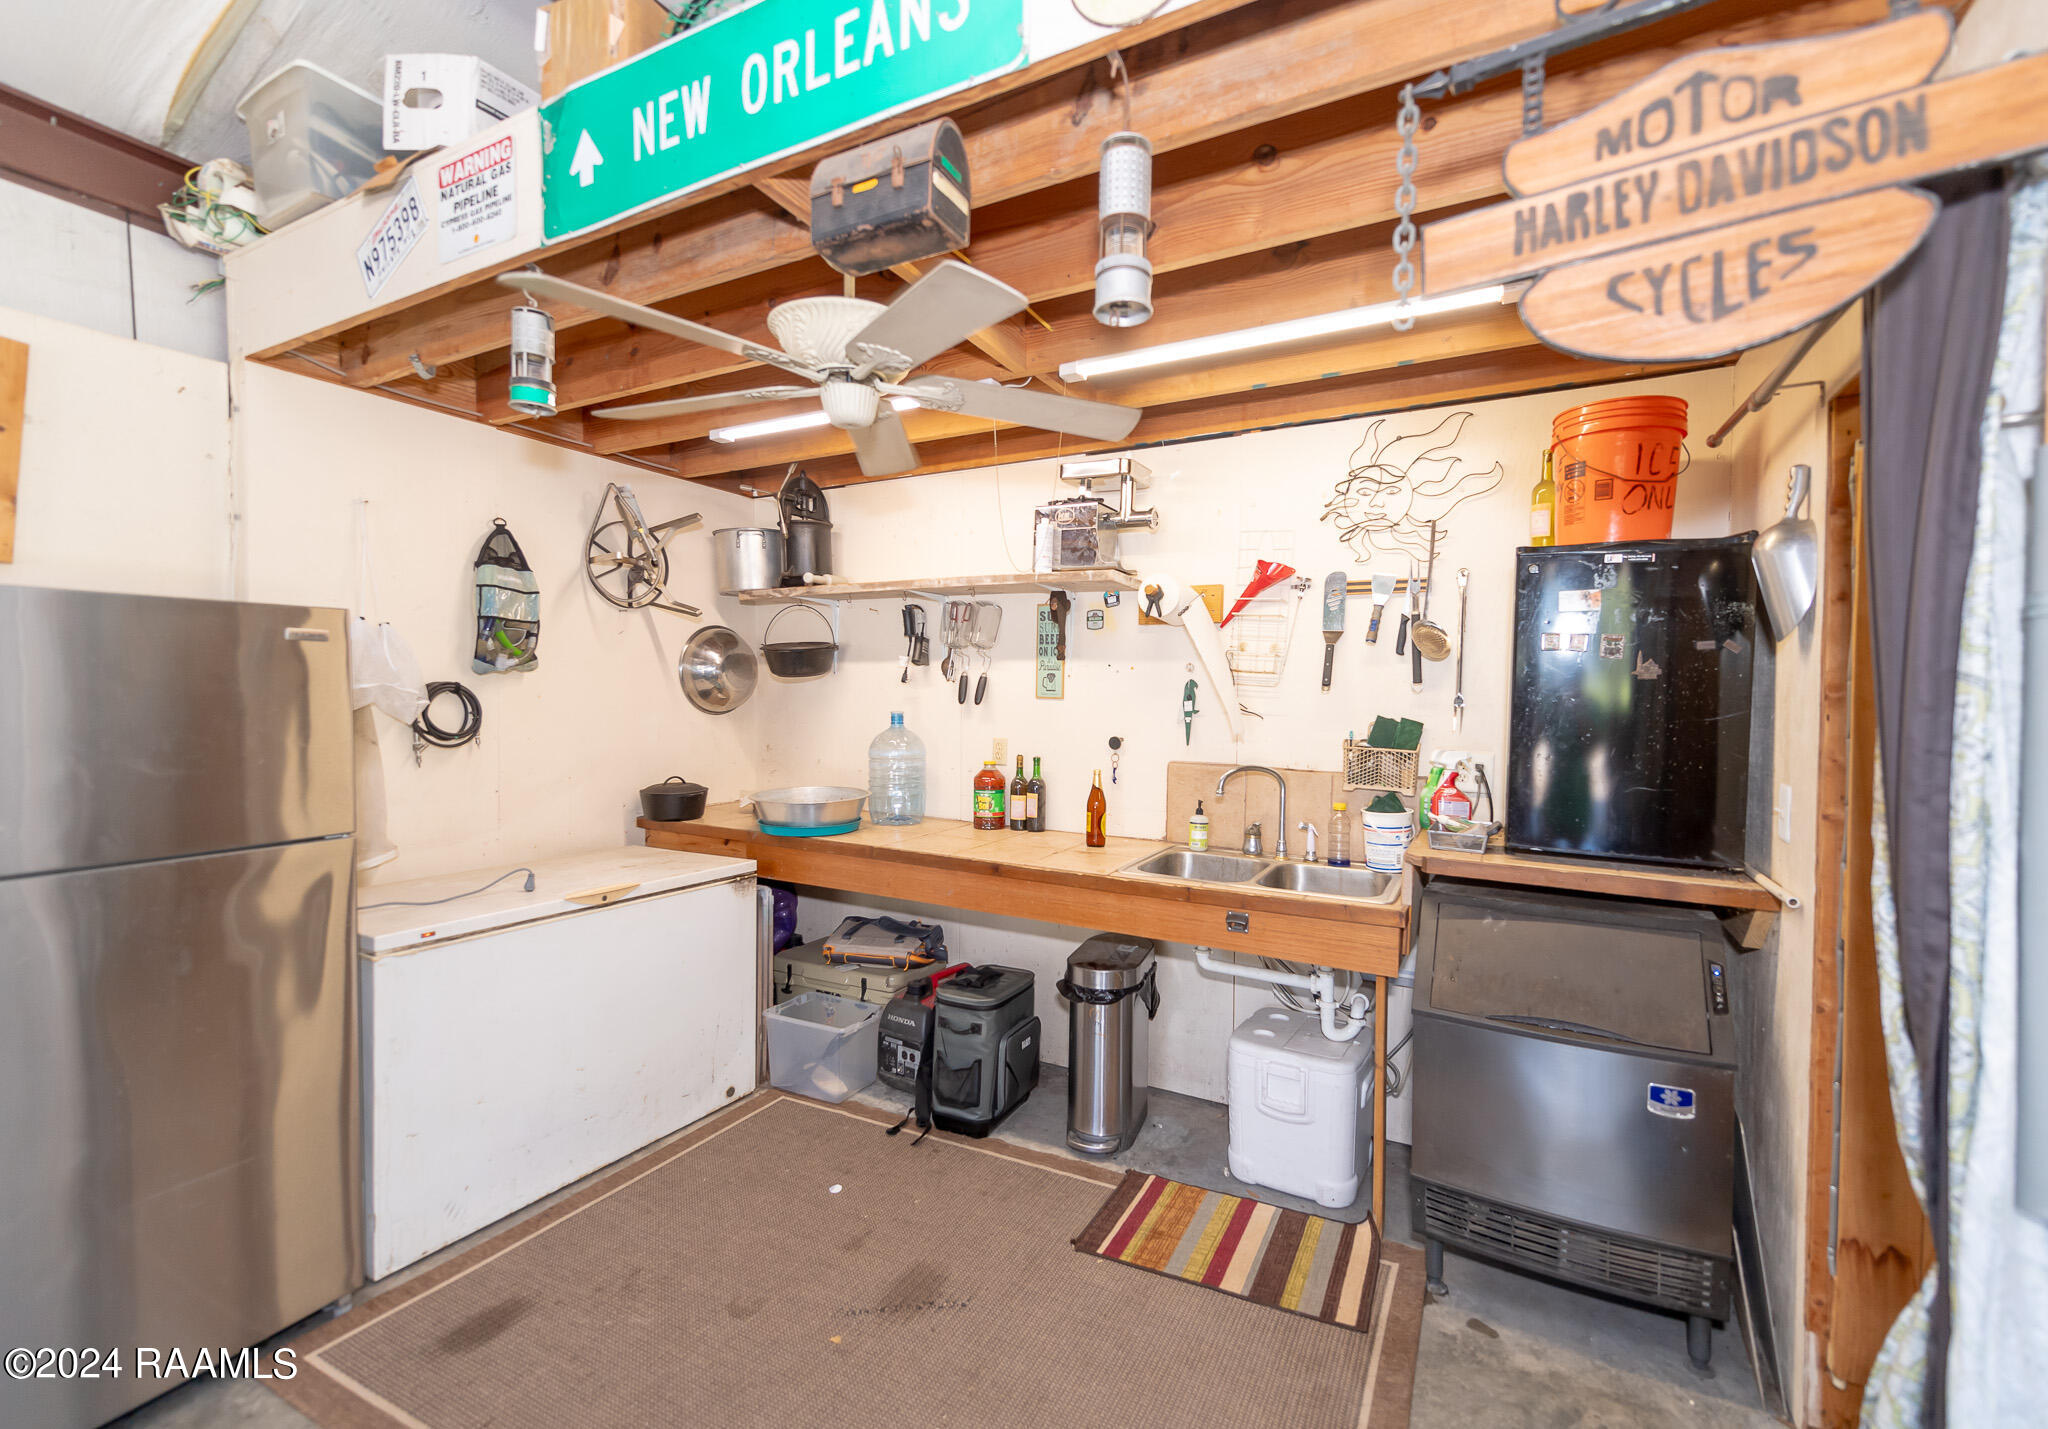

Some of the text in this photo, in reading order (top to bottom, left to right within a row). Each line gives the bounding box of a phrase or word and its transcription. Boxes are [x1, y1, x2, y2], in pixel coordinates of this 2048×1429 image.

[633, 0, 970, 162] NEW ORLEANS
[1595, 70, 1803, 162] MOTOR
[440, 138, 511, 187] WARNING
[441, 161, 512, 201] NATURAL GAS
[1514, 94, 1929, 256] HARLEY DAVIDSON
[454, 185, 499, 213] PIPELINE
[363, 196, 420, 282] N975398
[1606, 226, 1819, 324] CYCLES
[1635, 442, 1679, 476] ICE
[1622, 483, 1673, 515] ONL
[1038, 646, 1048, 657] ON
[887, 1013, 916, 1027] HONDA
